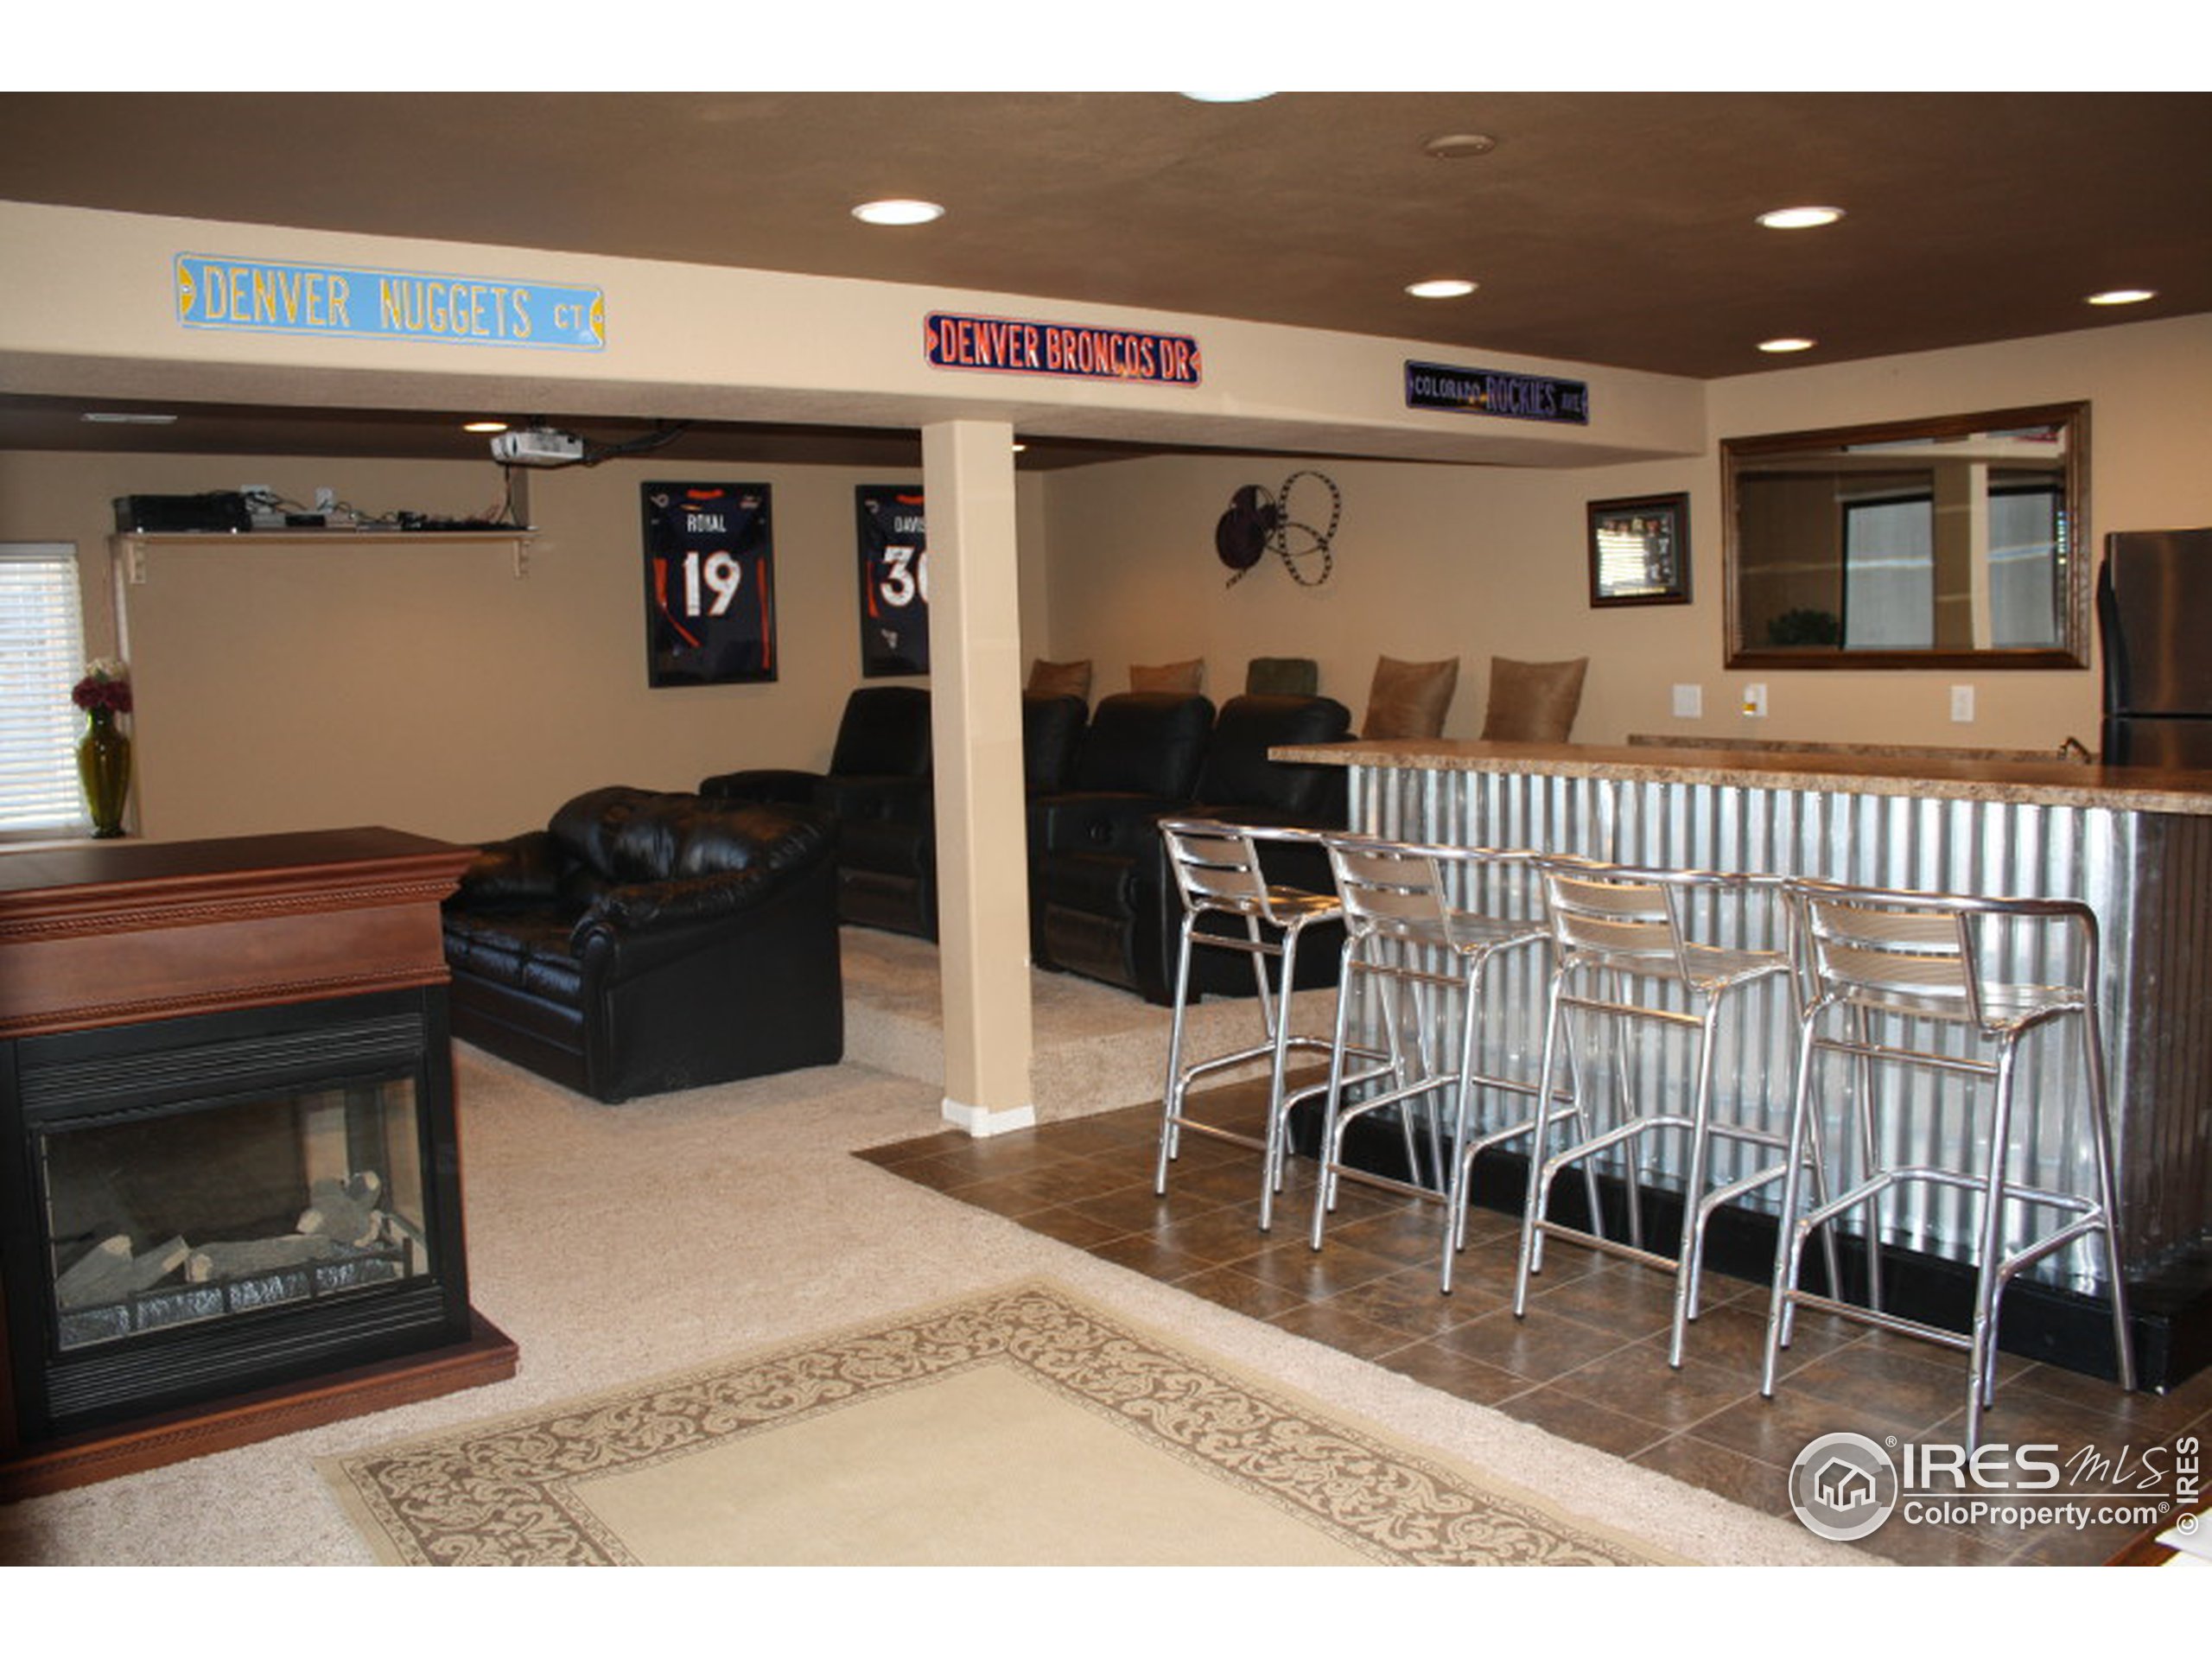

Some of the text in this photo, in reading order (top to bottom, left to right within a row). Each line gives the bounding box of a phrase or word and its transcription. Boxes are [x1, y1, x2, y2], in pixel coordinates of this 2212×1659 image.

[203, 264, 584, 338] DENVER NUGGETS CT
[940, 319, 1191, 380] DENVER BRONCOS DR
[1414, 375, 1481, 400] COLORADO
[1485, 376, 1556, 416] ROCKIES
[683, 550, 741, 618] 19
